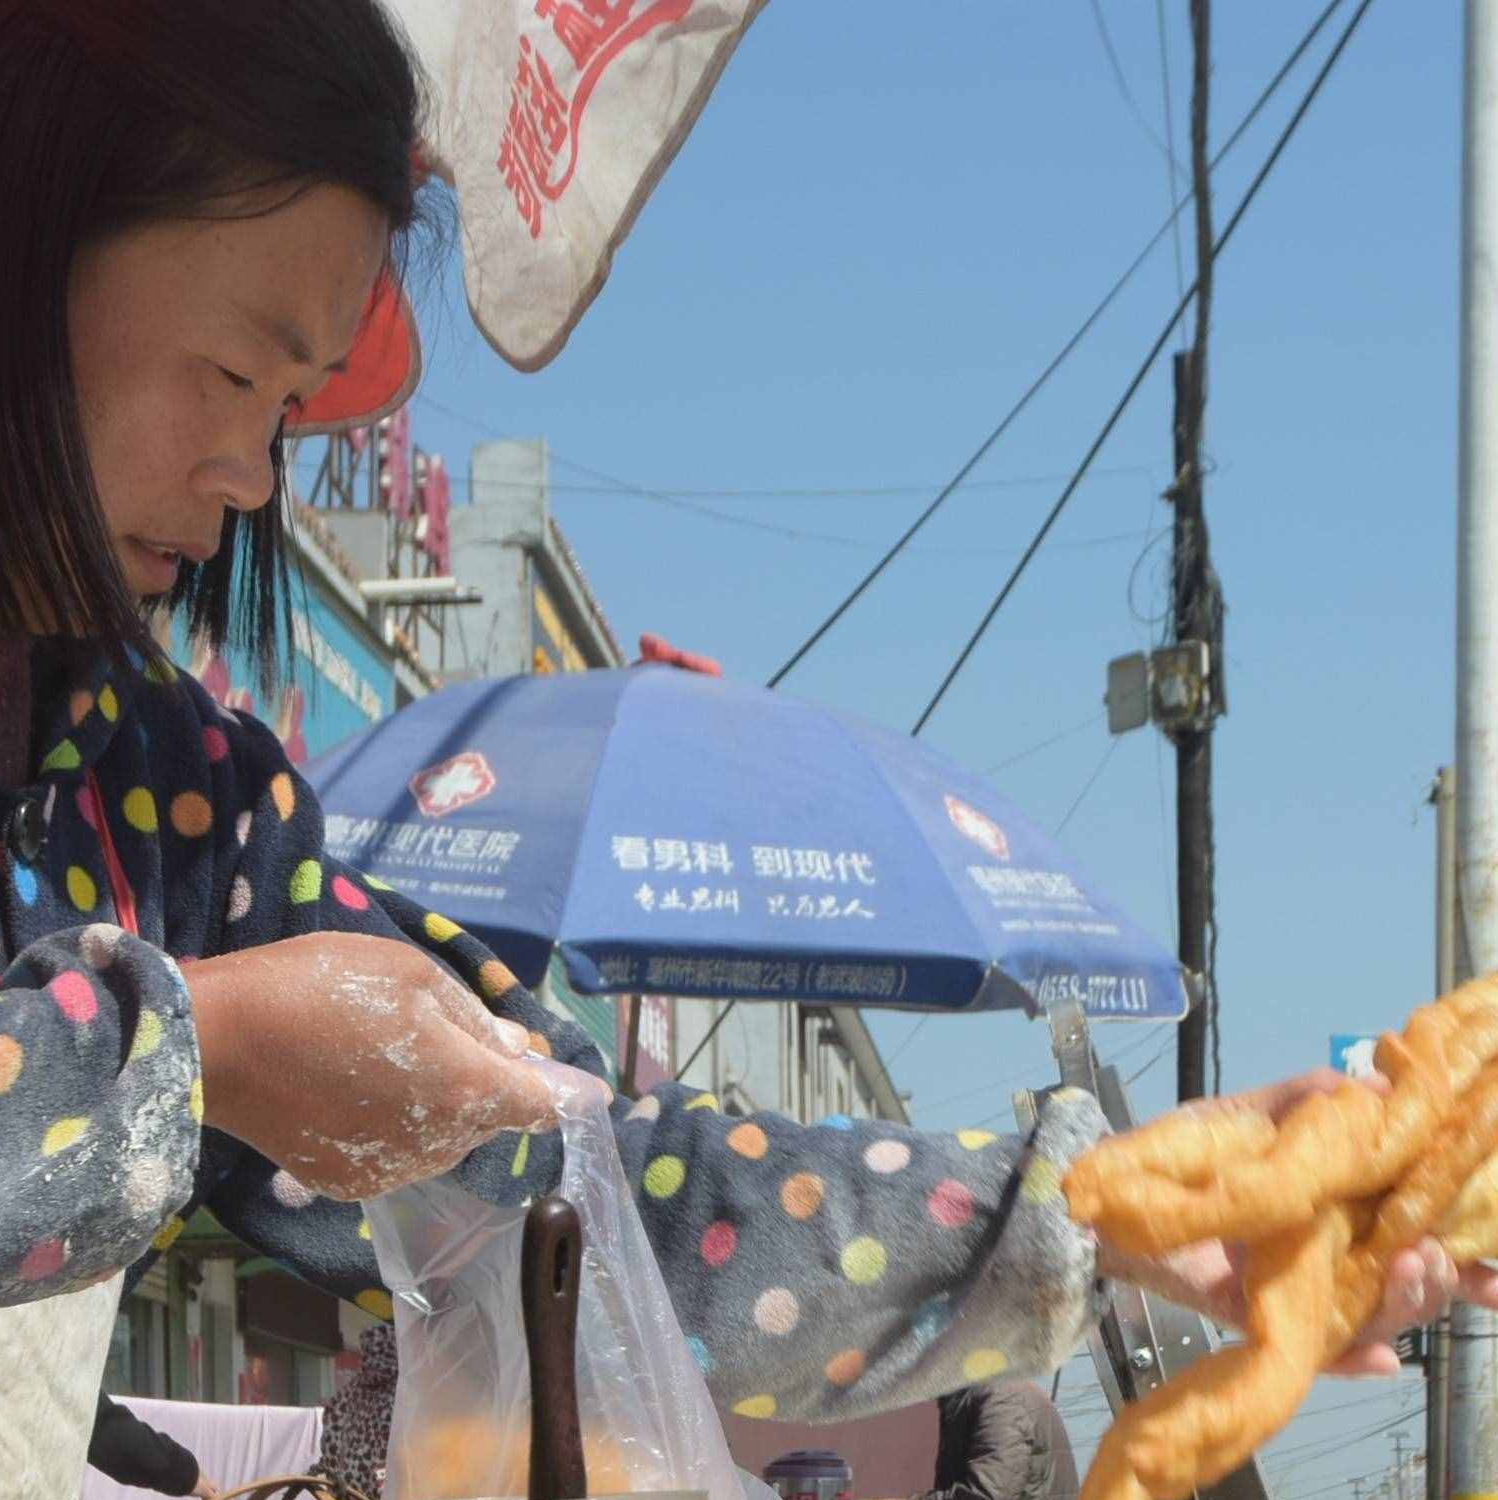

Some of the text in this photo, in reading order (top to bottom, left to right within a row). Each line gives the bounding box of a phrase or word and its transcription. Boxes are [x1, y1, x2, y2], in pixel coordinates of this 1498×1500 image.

[611, 834, 877, 887] 看男科 到现代
